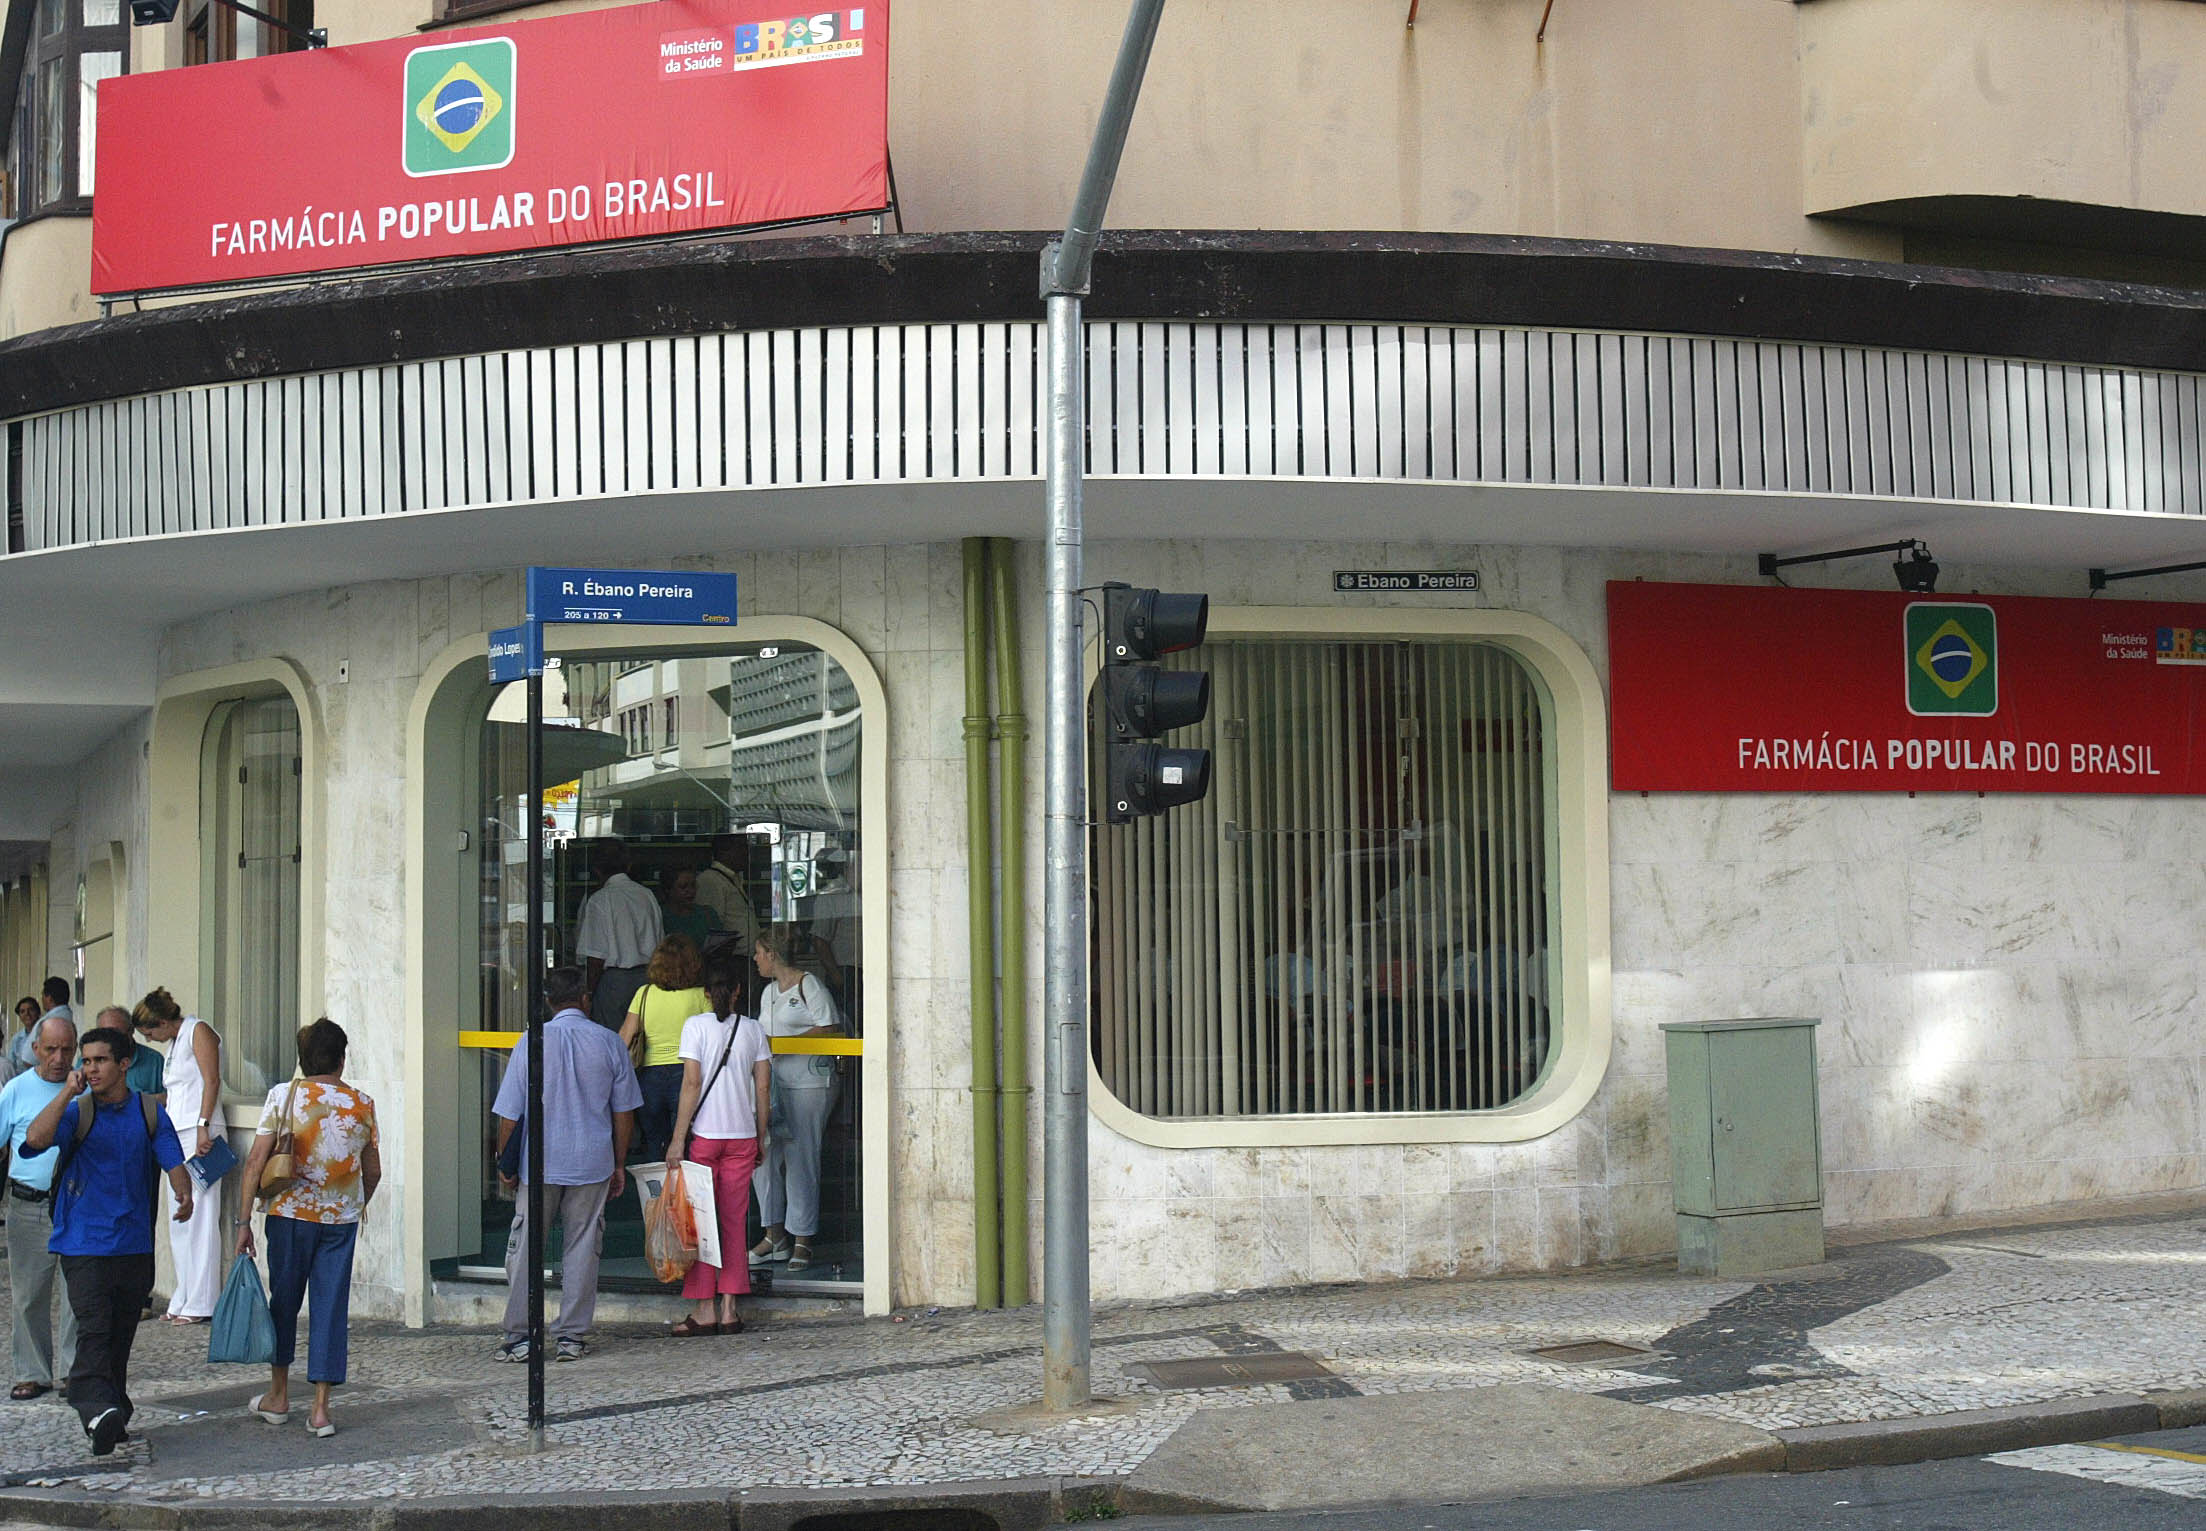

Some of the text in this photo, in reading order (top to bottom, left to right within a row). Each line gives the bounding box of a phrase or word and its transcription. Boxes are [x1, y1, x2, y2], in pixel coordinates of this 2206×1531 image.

[660, 37, 723, 57] Ministério
[736, 39, 861, 63] UM PAÍS DE TODOS
[665, 54, 723, 73] da Saúde
[211, 171, 725, 257] FARMÁCIA POPULAR DO BRASIL
[562, 578, 693, 599] R. Ébano Pereira
[1357, 573, 1476, 588] Ebano Pereira
[593, 612, 609, 620] 120
[702, 613, 730, 623] Centro
[2102, 633, 2148, 645] Ministério
[2106, 647, 2148, 659] da Saúde
[1738, 731, 2161, 775] FARMÁCIA POPULAR DO BRASIL
